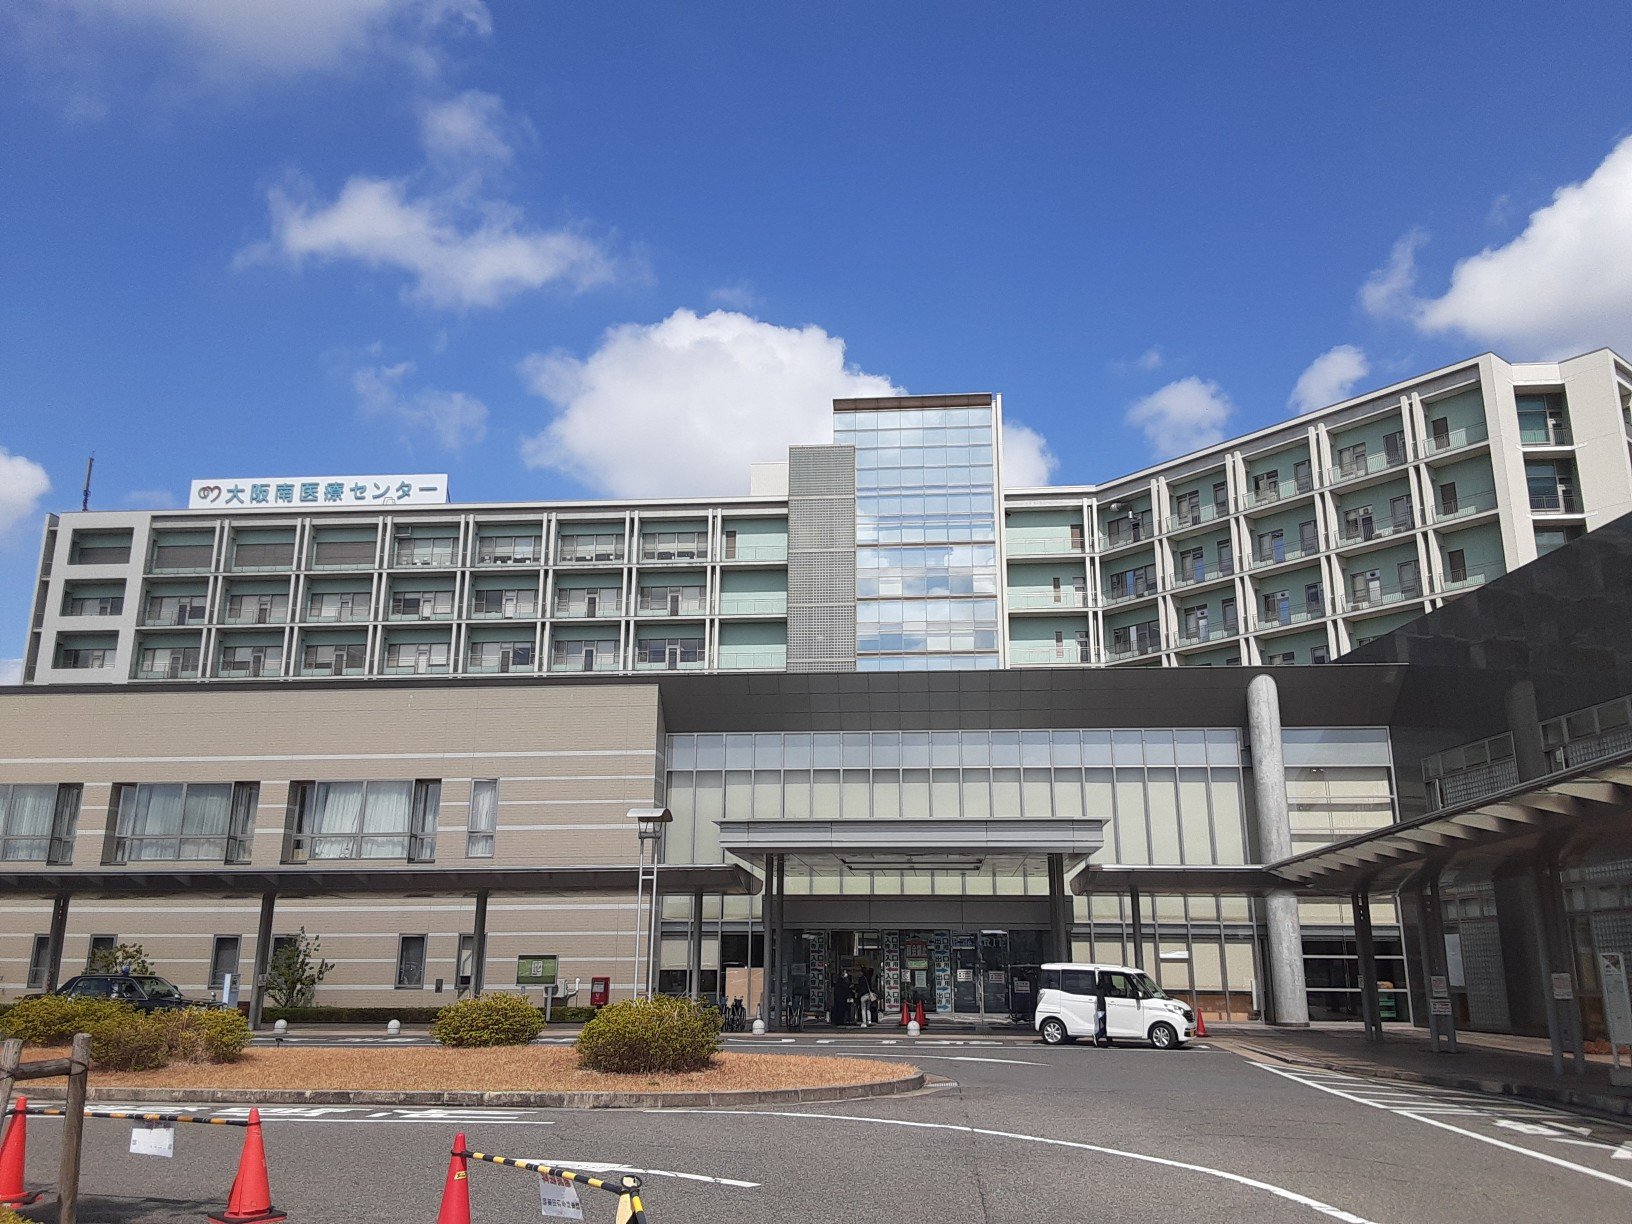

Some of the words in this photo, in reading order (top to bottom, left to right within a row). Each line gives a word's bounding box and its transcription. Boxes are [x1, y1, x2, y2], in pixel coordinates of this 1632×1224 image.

[224, 480, 438, 504] 大阪南医療センター
